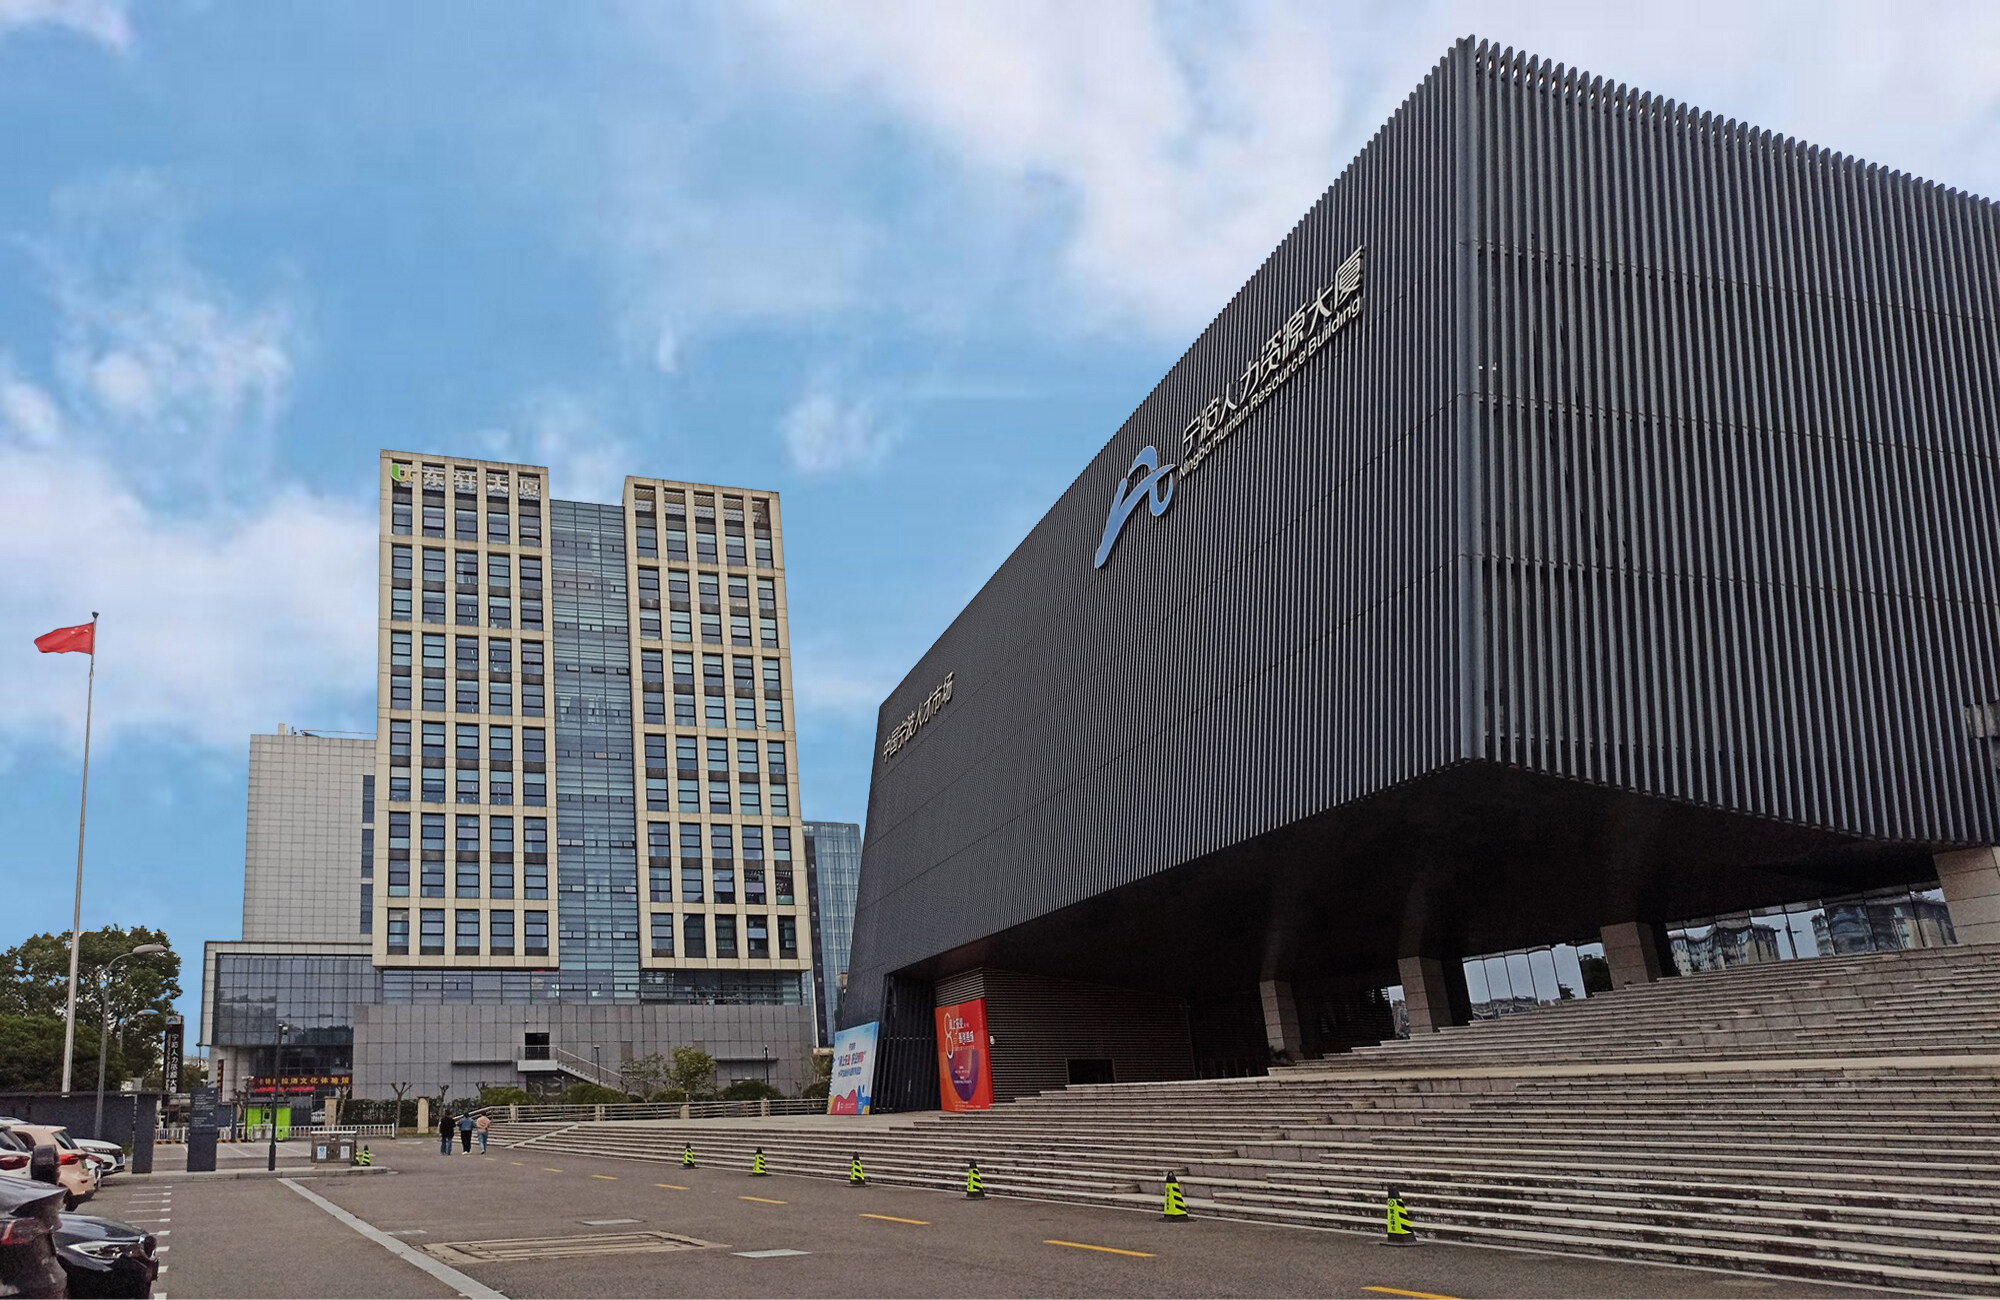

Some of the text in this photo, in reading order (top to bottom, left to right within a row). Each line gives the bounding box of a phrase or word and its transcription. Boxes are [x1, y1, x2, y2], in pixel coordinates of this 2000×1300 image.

[1179, 296, 1361, 477] Ningbo Human Resource Building
[1183, 244, 1364, 459] 宁波人力资源大厦
[882, 671, 955, 764] 中国宁波人才市场
